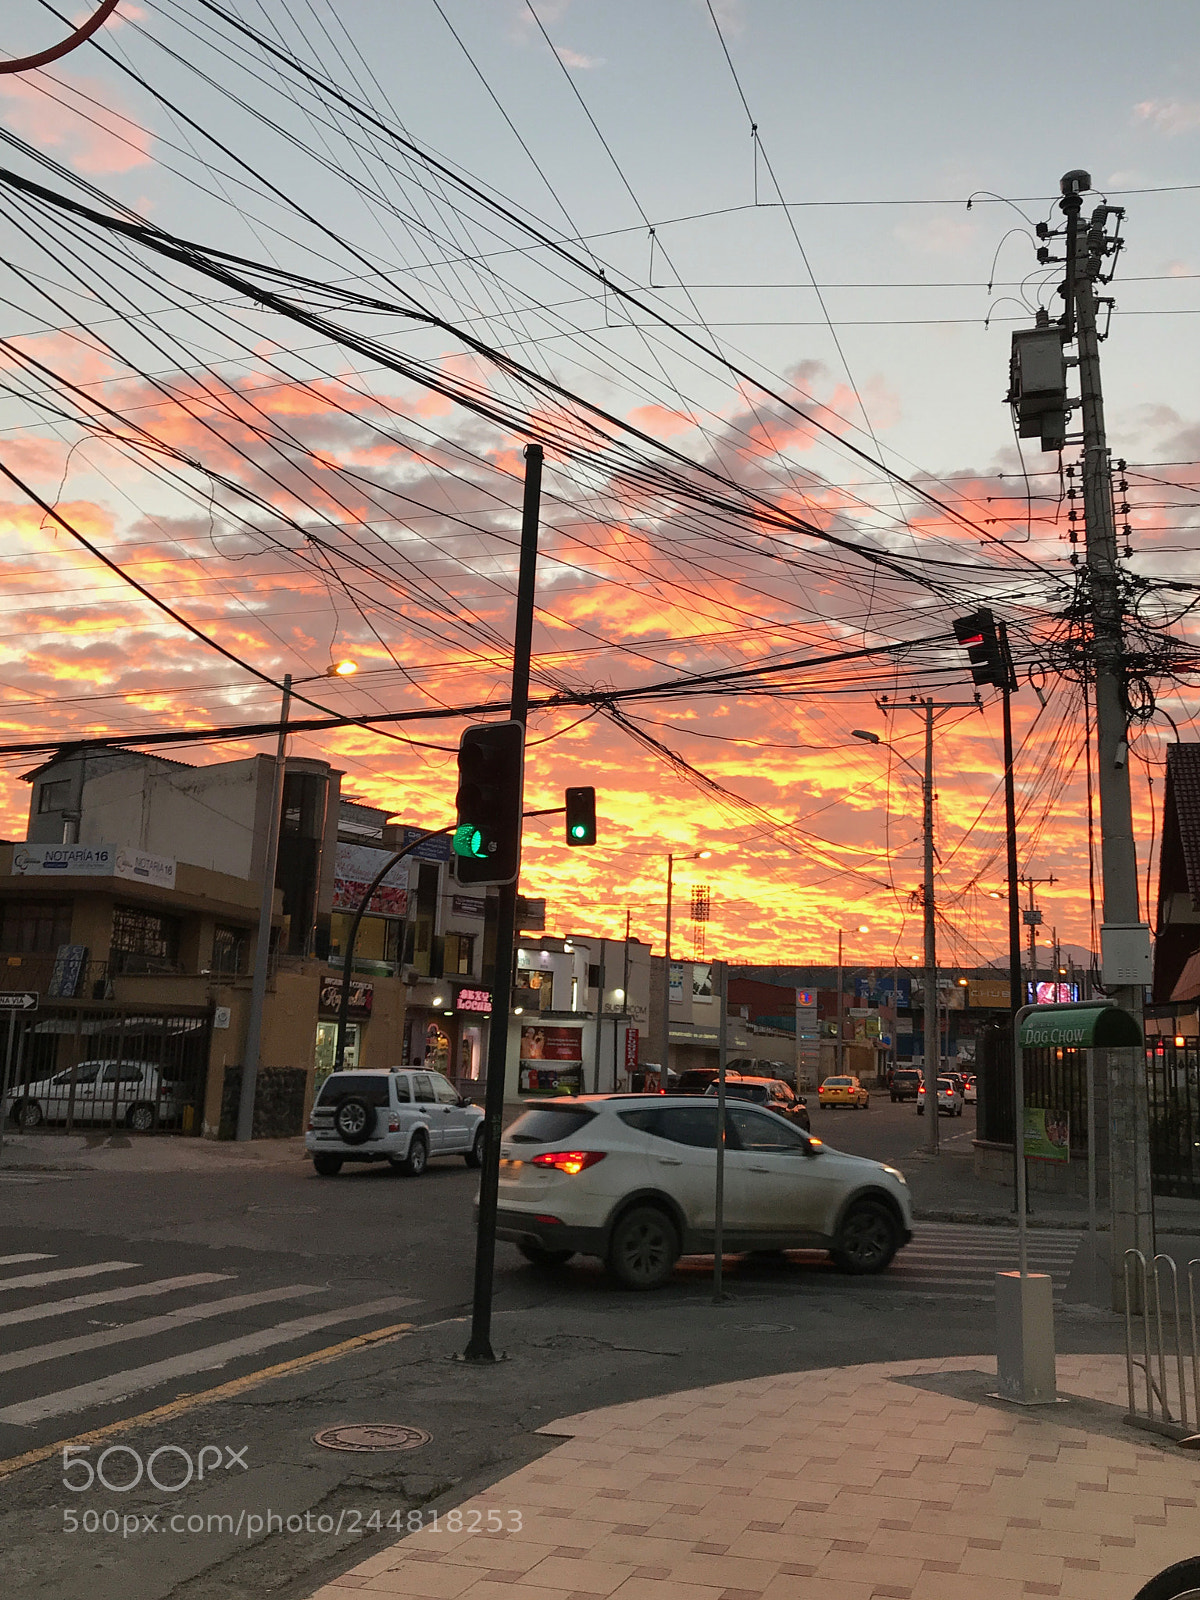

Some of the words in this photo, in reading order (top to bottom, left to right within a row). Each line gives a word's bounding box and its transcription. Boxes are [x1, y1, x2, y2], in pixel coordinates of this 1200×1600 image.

[45, 848, 93, 861] NOTARÍA
[95, 851, 108, 862] 16
[164, 864, 173, 876] 16
[459, 989, 490, 1001] SEXY
[457, 998, 493, 1012] LOCUR
[1025, 1029, 1049, 1045] DOG
[1051, 1028, 1085, 1044] CHOW
